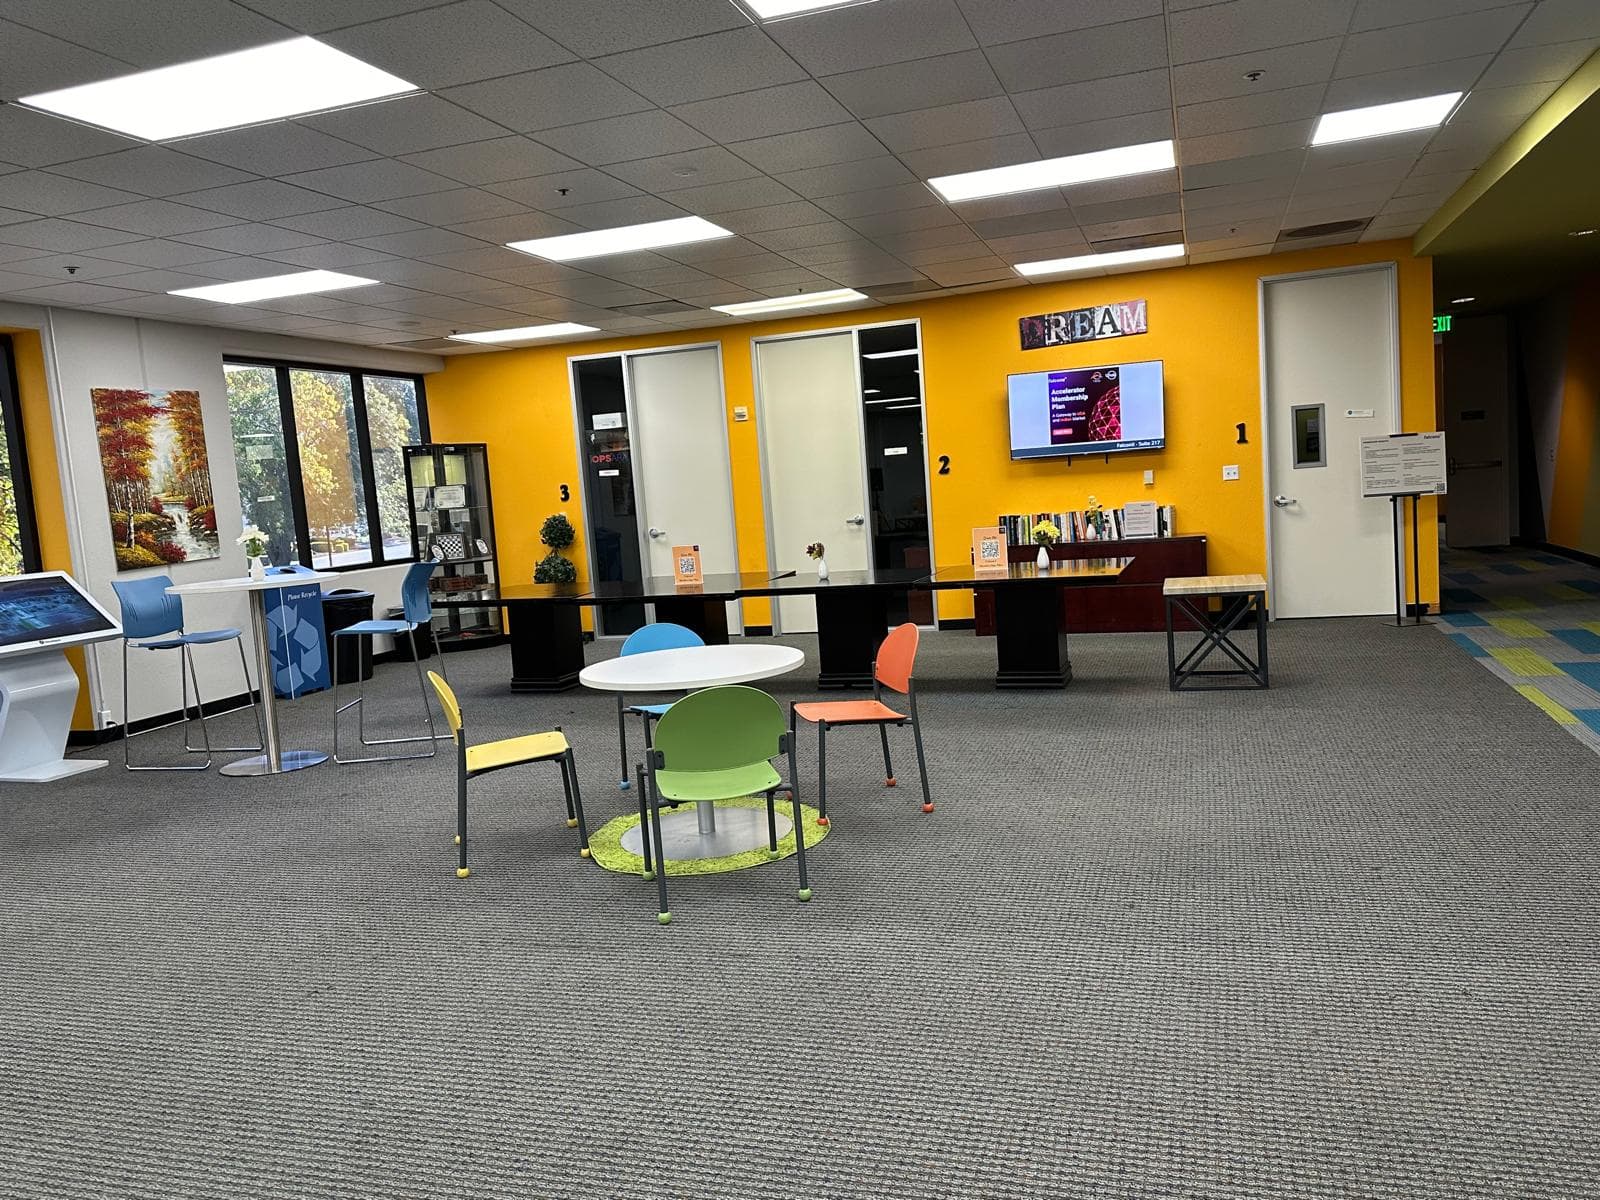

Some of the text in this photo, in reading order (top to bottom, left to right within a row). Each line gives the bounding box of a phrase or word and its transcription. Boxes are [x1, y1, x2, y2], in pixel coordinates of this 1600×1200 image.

[1021, 302, 1147, 346] DREAM
[1433, 315, 1452, 332] EXIT
[1051, 387, 1086, 395] Accelerator
[1051, 394, 1089, 402] Membership
[1236, 422, 1249, 444] 1
[938, 455, 950, 475] 2
[559, 484, 570, 502] 3
